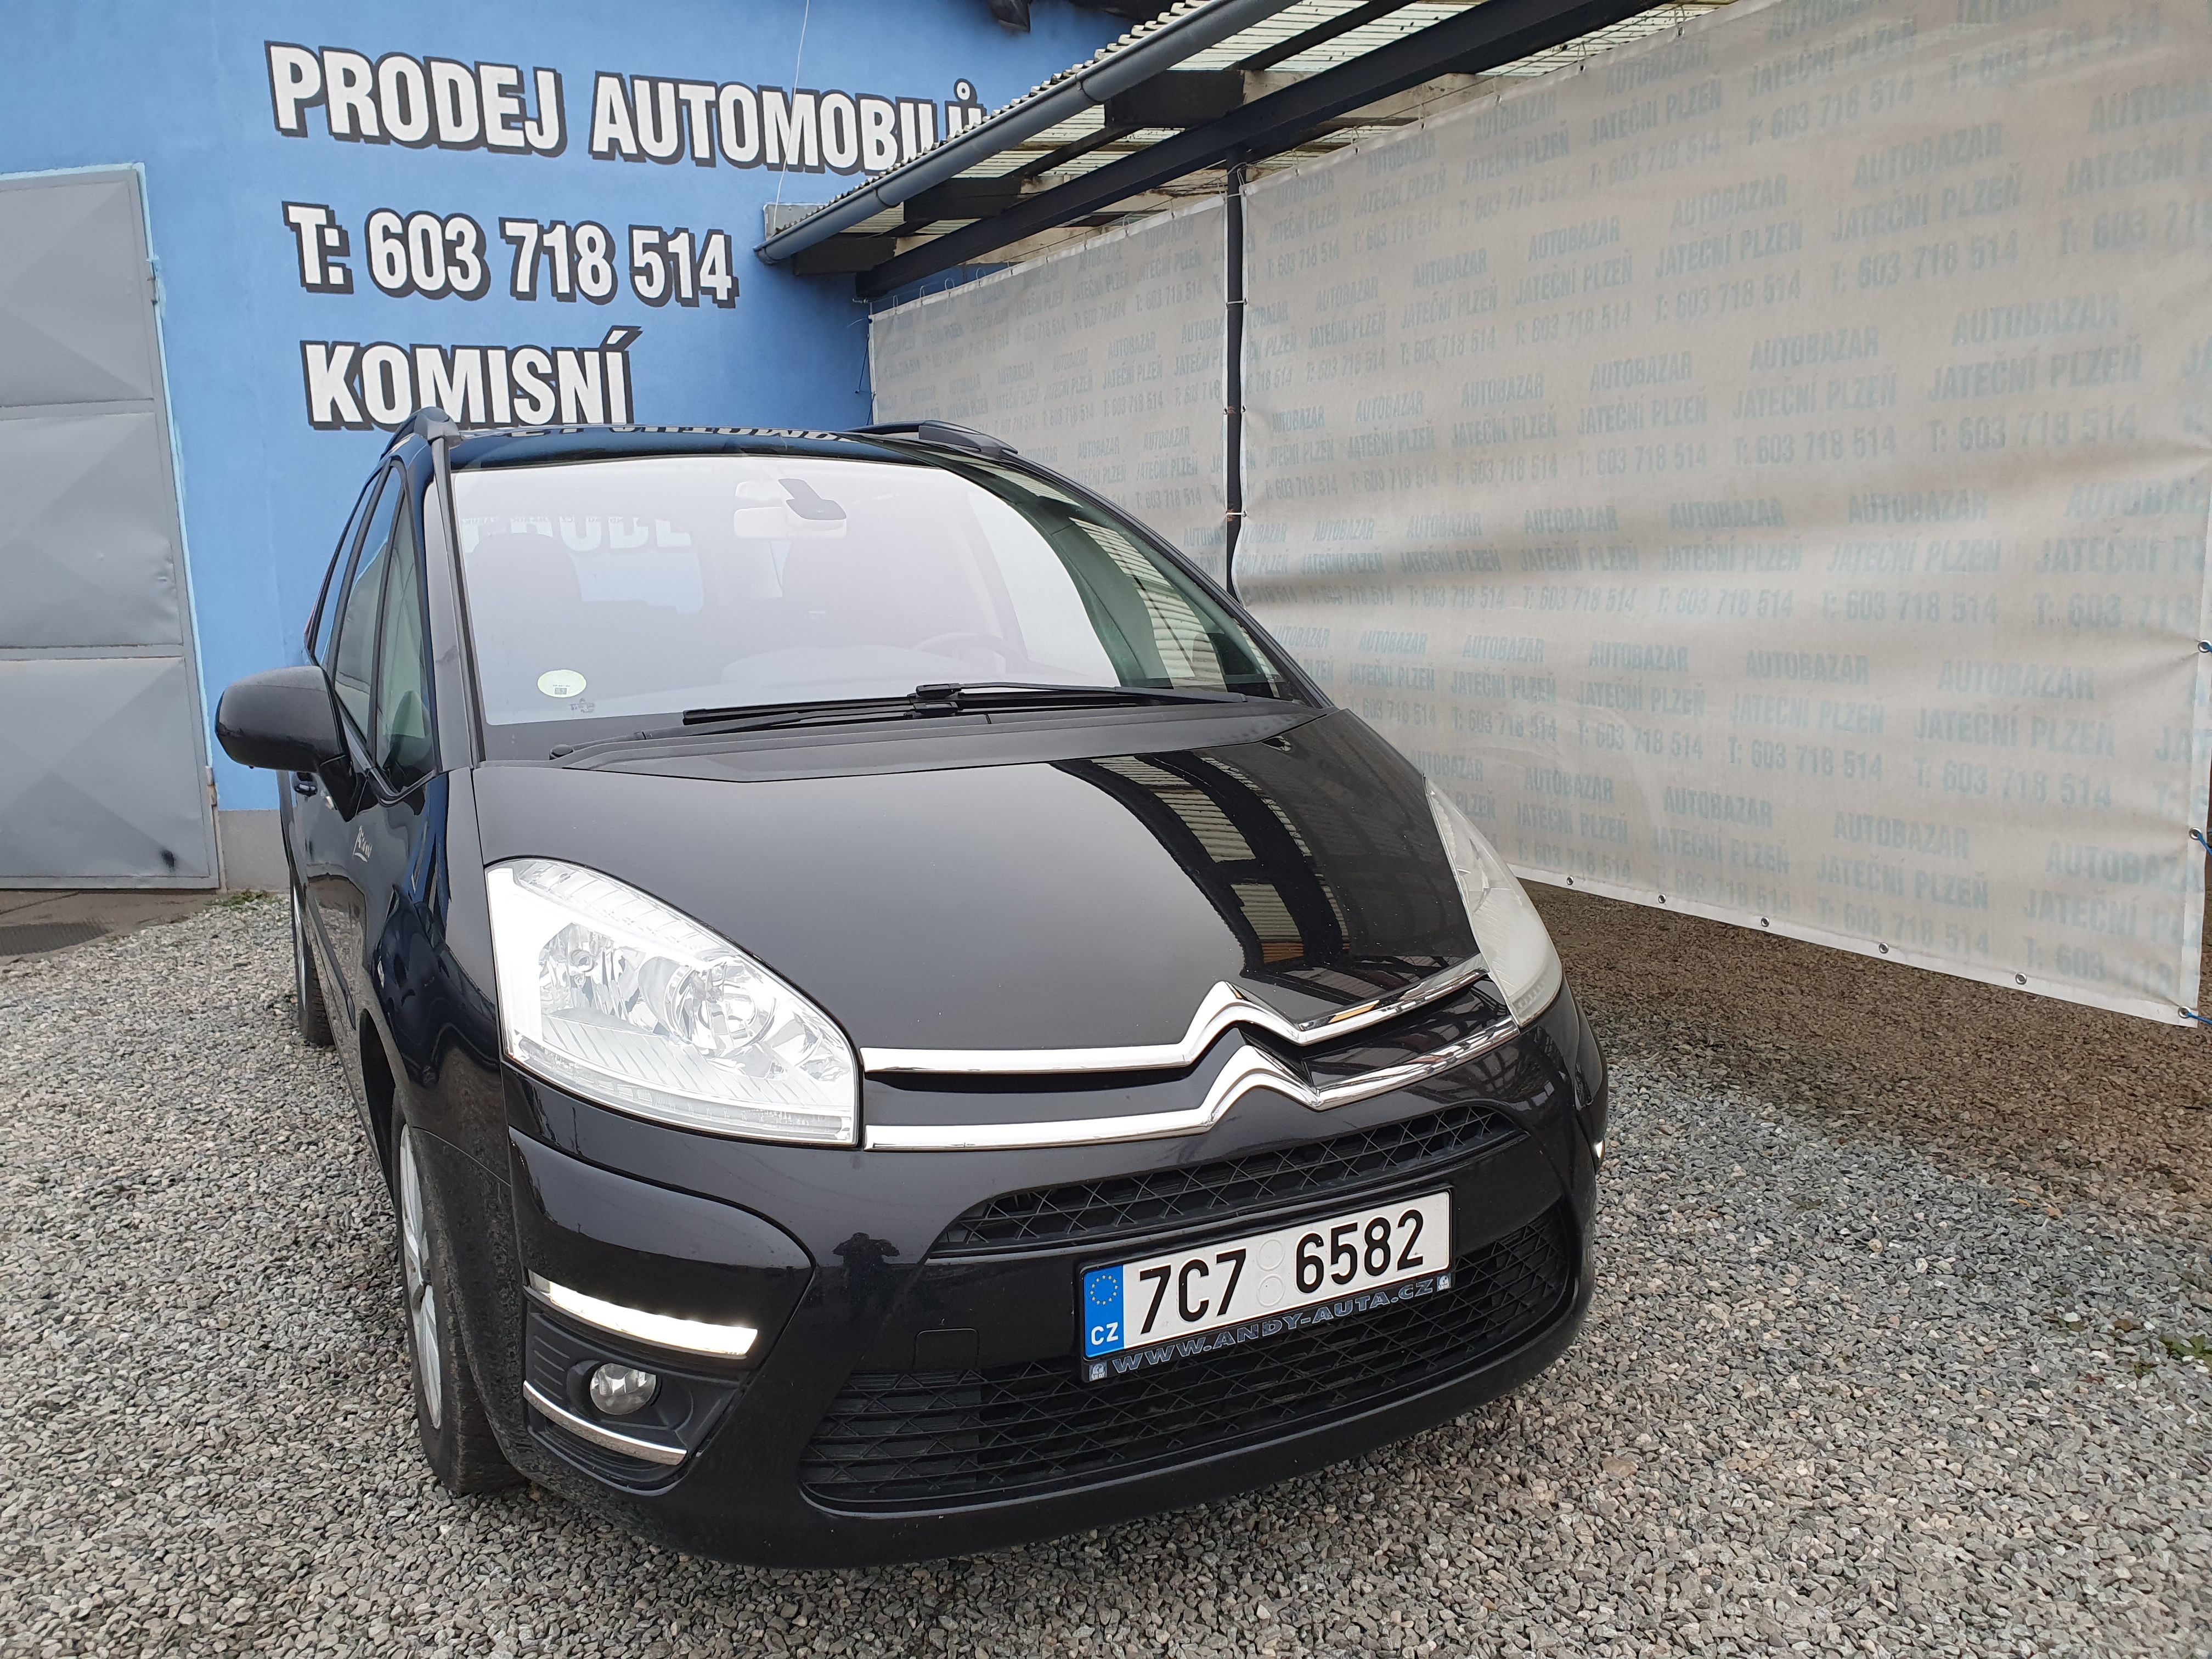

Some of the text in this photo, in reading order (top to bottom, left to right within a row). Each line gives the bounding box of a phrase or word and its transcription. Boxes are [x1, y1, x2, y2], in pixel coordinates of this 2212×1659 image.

[265, 41, 986, 176] PRODEJ AUTOMOBILŮ
[1853, 123, 2003, 189] AUTOBAZAR
[1671, 175, 1787, 230] AUTOBAZAR
[281, 201, 739, 308] T: 603 718 514
[1953, 295, 2119, 346] AUTOBAZAR
[1750, 328, 1880, 370] AUTOBAZAR
[300, 325, 643, 430] KOMISNÍ
[1462, 374, 1544, 408] AUTOBAZAR
[1590, 352, 1692, 391] AUTOBAZAR
[1407, 516, 1482, 540] AUTOBAZAR
[1524, 507, 1619, 535] AUTOBAZAR
[1669, 499, 1787, 531] AUTOBAZAR
[1462, 637, 1545, 663] AUTOBAZAR
[1589, 644, 1689, 674] AUTOBAZAR
[1746, 651, 1869, 685] AUTOBAZAR
[1939, 661, 2095, 701] AUTOBAZAR
[1835, 812, 1969, 859] AUTOBAZAR
[1139, 1209, 1424, 1335] 7C7 6582
[1091, 1322, 1119, 1346] CZ
[1112, 1279, 1435, 1373] WWW.ANDY-AUTA.CZ
